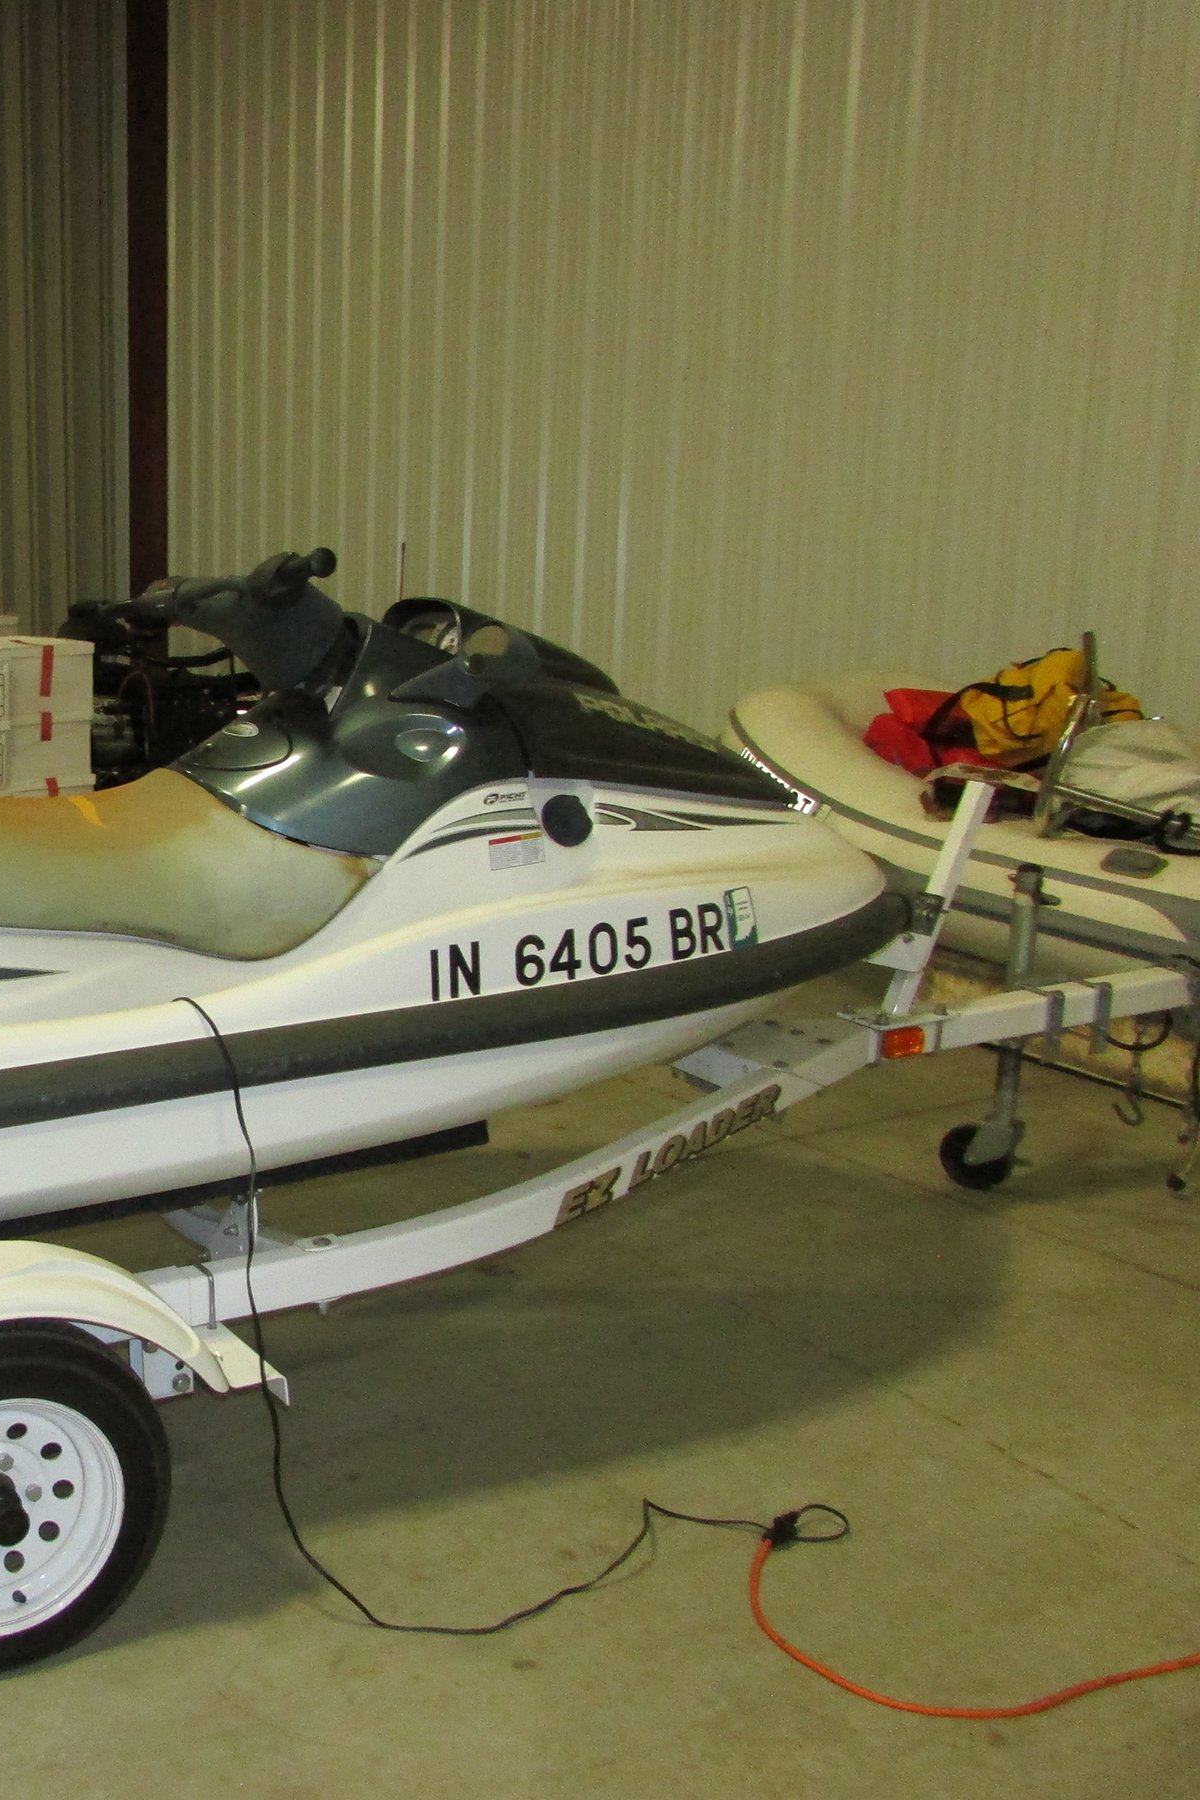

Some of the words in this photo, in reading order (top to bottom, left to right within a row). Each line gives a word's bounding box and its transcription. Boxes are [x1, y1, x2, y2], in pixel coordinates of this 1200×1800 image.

[430, 941, 481, 1001] IN
[515, 917, 652, 986] 6405
[669, 903, 726, 960] BR
[552, 1166, 622, 1230] EZ
[627, 1083, 782, 1191] LOADER
